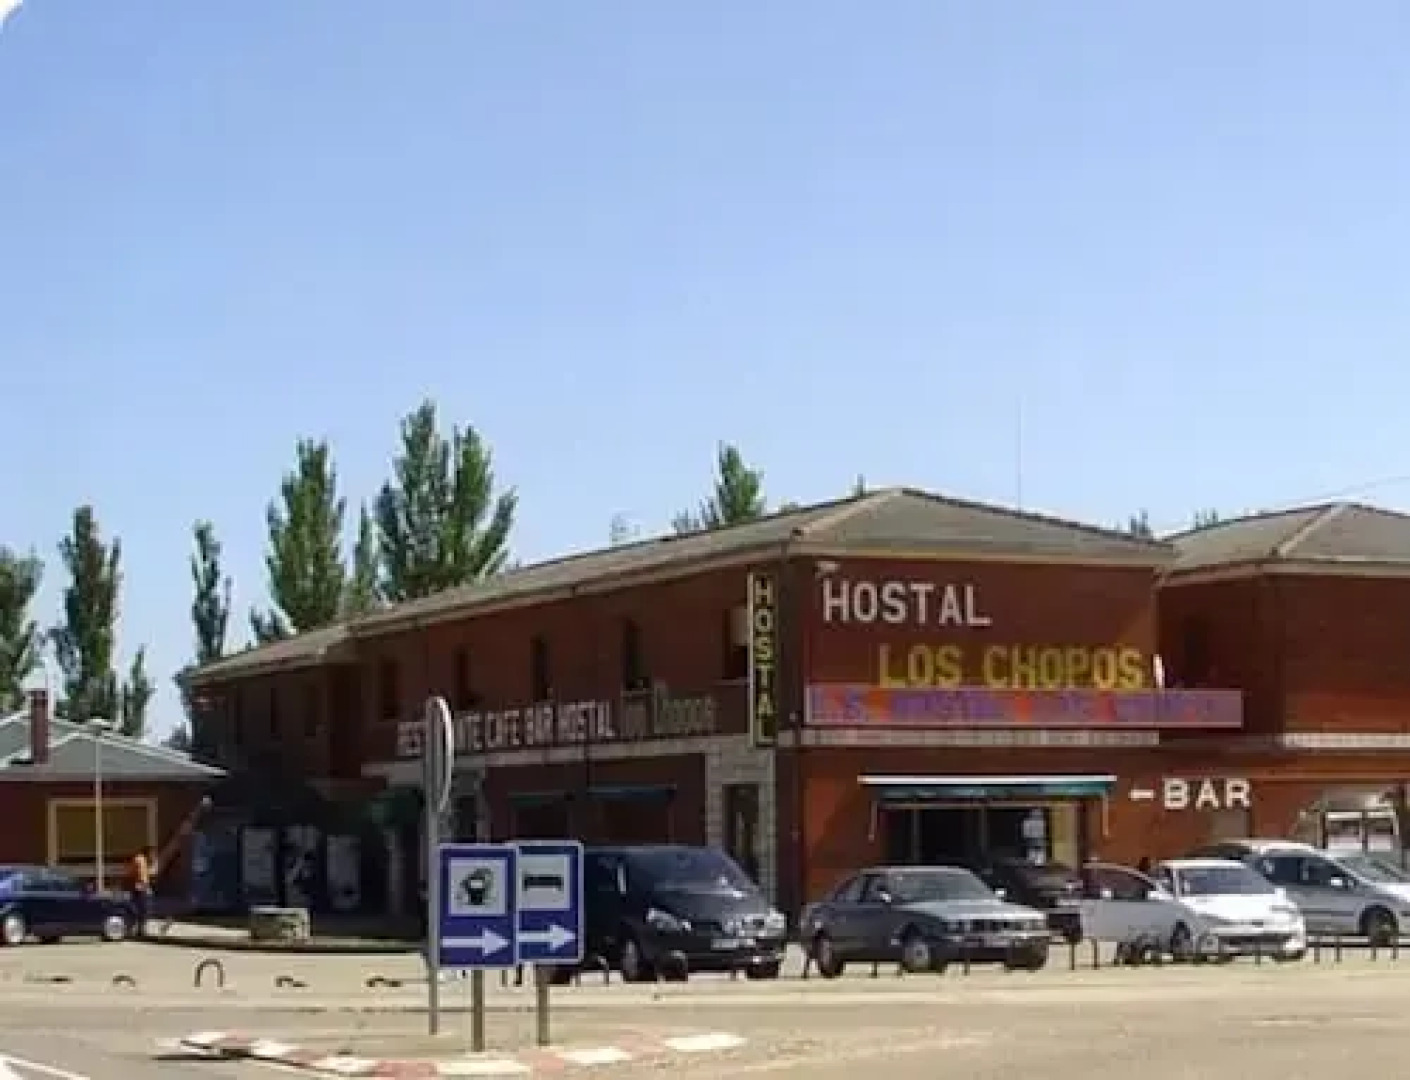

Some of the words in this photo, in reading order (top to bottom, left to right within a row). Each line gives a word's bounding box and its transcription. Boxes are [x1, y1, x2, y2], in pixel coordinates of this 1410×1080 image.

[822, 577, 993, 627] HOSTAL
[754, 578, 775, 743] HOSTAL
[878, 642, 963, 688] LOS
[982, 643, 1145, 690] CHOPOS
[525, 703, 554, 746] BAR
[1163, 778, 1251, 810] BAR
